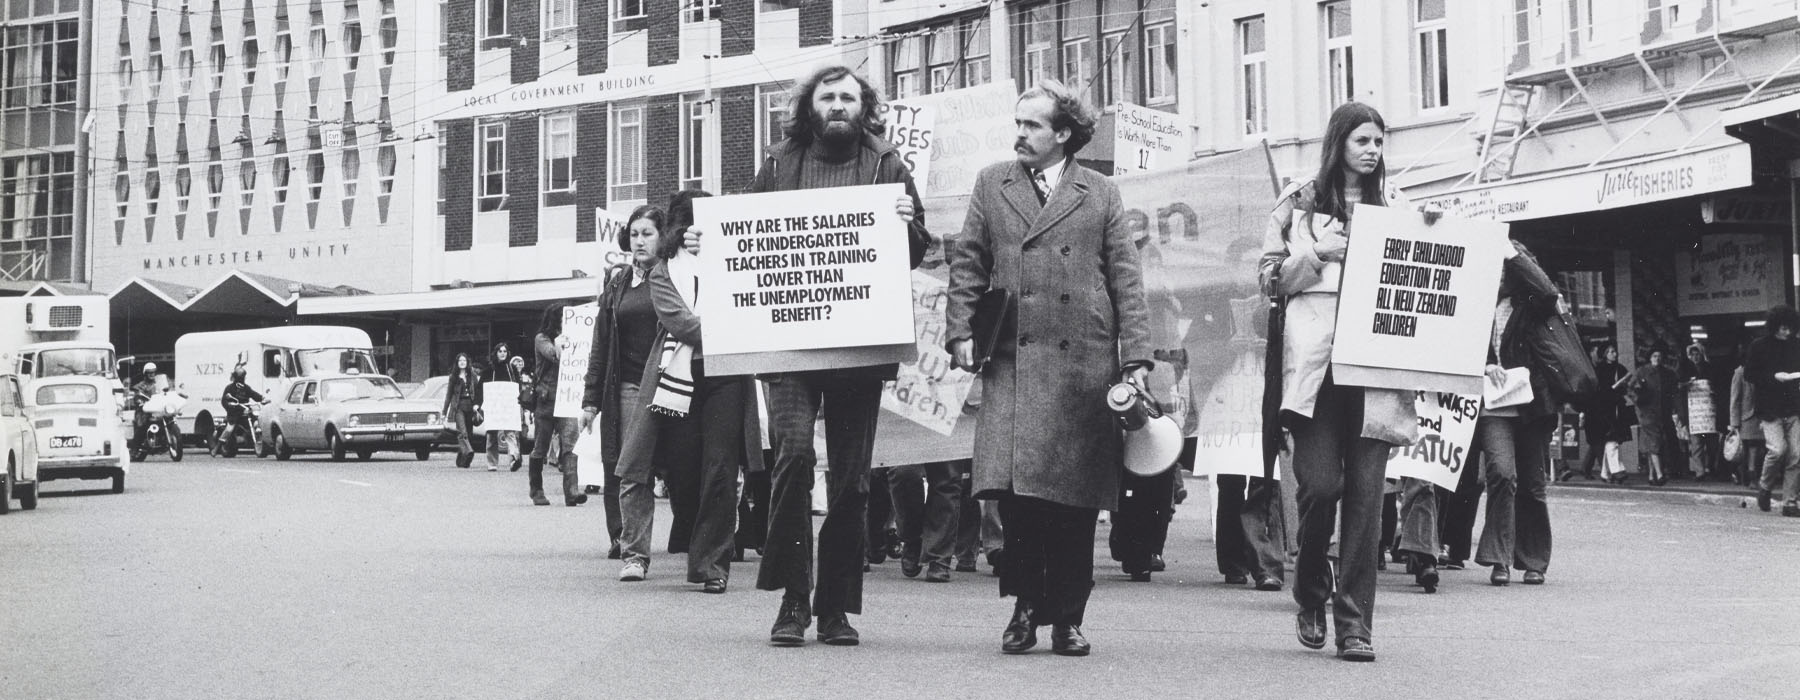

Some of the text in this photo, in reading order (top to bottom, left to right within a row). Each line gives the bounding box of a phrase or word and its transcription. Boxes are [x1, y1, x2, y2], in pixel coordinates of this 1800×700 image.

[463, 74, 656, 107] LOCAL GOVERNMENT BUILDING
[1152, 115, 1183, 138] Education
[1124, 125, 1141, 143] Worth
[1156, 136, 1173, 153] Than
[1597, 165, 1694, 204] Jurie FISHERIES
[1498, 200, 1530, 216] RESTAURANT
[721, 212, 876, 236] WHY ARE THE SALARIES
[737, 231, 860, 253] OF KINDERGARTEN
[1383, 237, 1466, 268] EARLY CHILDHOOD
[143, 243, 349, 270] MANCHESTER UNITY
[725, 248, 877, 272] TEACHERS IN TRAINING
[756, 268, 844, 288] LOWER THAN
[1379, 262, 1452, 291] EDUCATION FOR
[733, 285, 872, 308] THE UNEMPLOYMENT
[1376, 287, 1458, 317] ALL NEW ZEALAND
[771, 304, 832, 323] BENEFIT?
[1372, 312, 1418, 338] CHILDREN
[195, 363, 224, 376] NZTS
[1416, 414, 1443, 433] and
